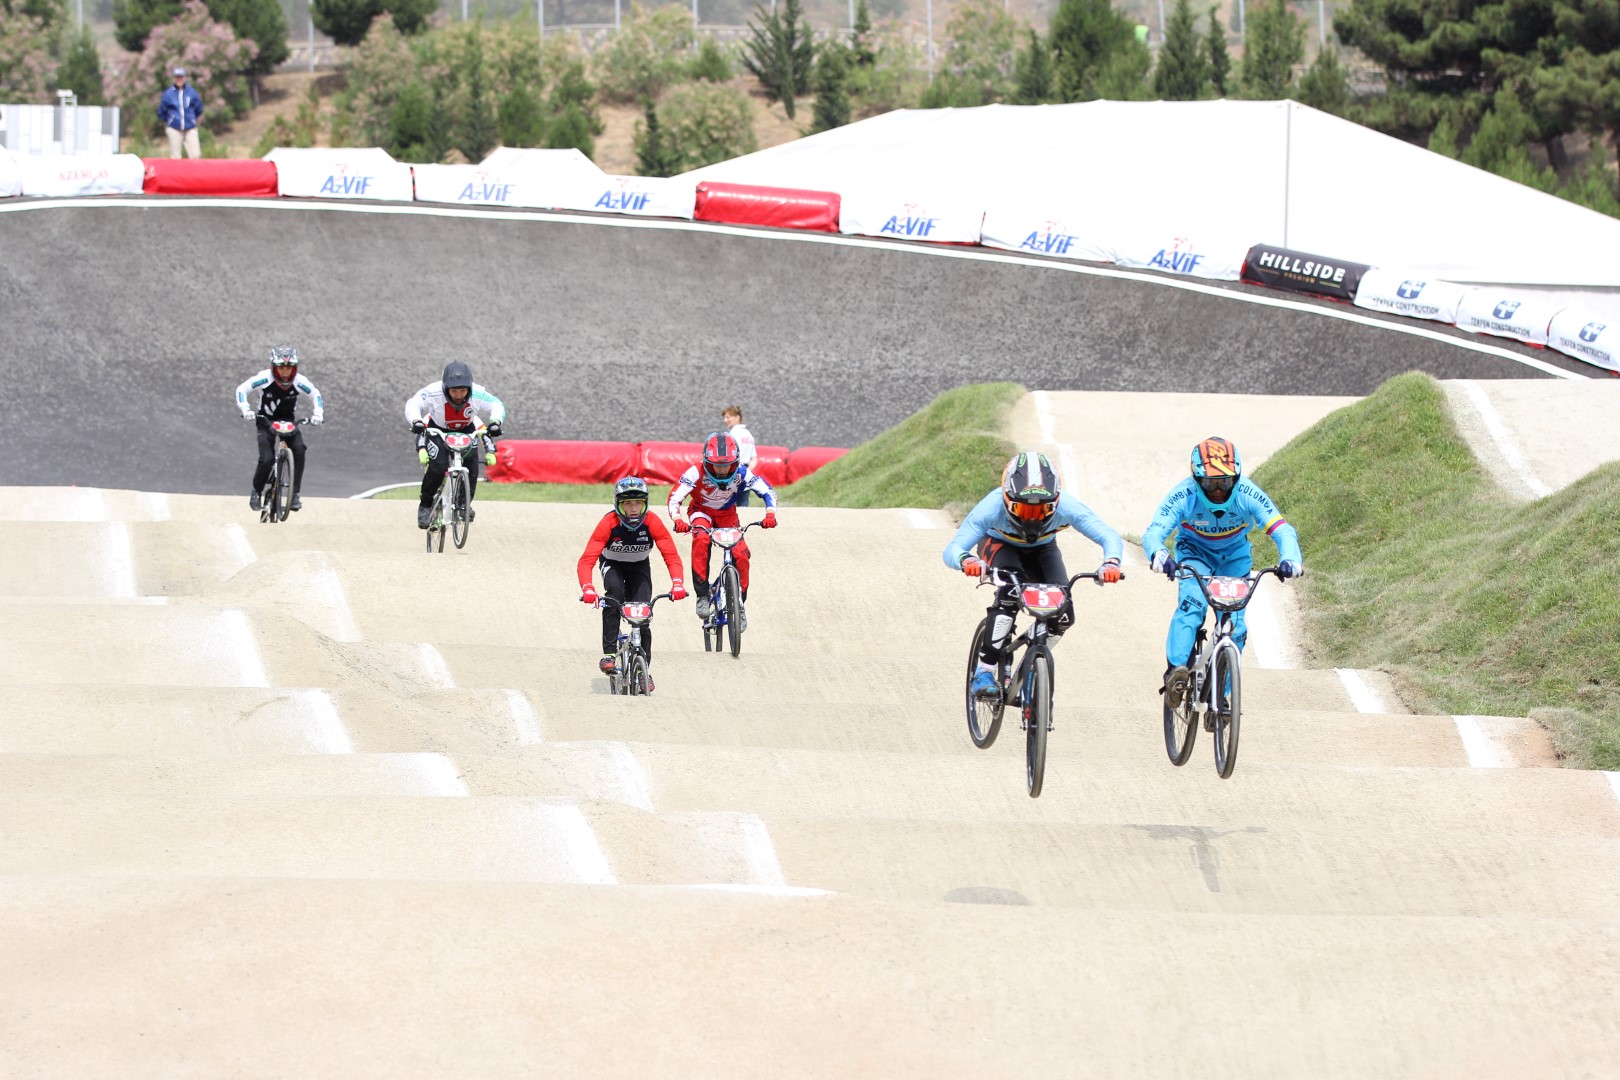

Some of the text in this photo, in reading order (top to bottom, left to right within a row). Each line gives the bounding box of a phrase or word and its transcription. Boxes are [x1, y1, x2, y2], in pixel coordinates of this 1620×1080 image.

[1259, 252, 1346, 283] HILLSIDE
[1396, 301, 1440, 315] CONSTRUCTION
[1491, 320, 1531, 337] CONSTRUCTION
[1577, 342, 1611, 362] CONSTRUCTION
[1161, 487, 1193, 517] COLOMBIA
[1238, 483, 1274, 515] COLOMBIA
[1191, 520, 1245, 533] COLOMB
[610, 544, 650, 553] FRANCE
[1220, 582, 1238, 597] 50
[1038, 591, 1049, 606] 5
